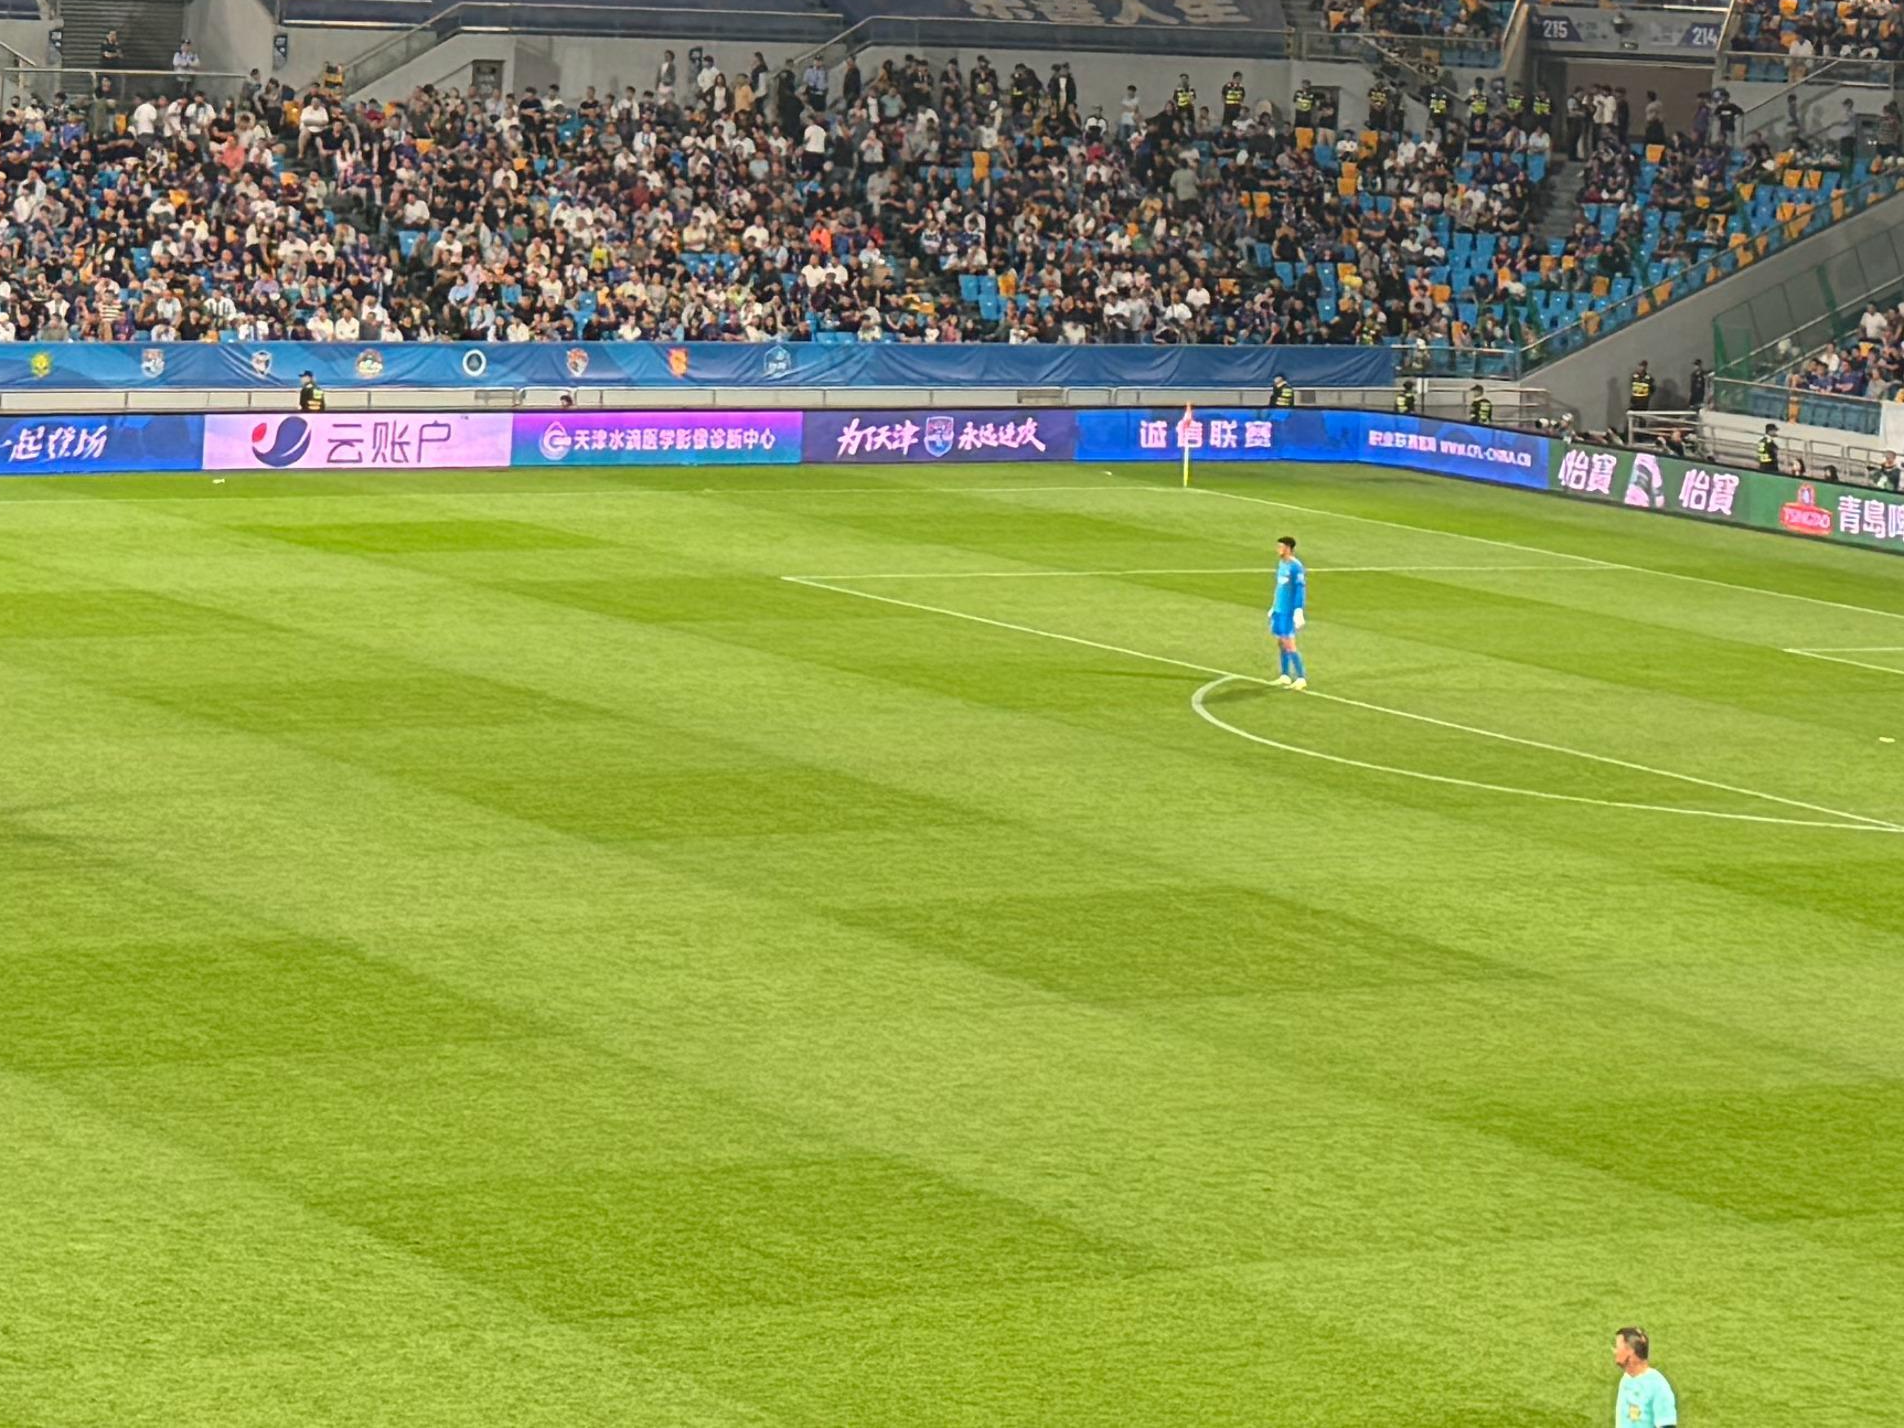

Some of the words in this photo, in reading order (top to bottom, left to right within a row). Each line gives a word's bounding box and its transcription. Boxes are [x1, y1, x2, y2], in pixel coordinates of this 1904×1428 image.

[1542, 19, 1569, 39] 215
[326, 421, 453, 466] 云账户
[1139, 420, 1273, 449] 诚信联赛
[1558, 446, 1619, 498] 怡寶
[1678, 466, 1740, 516] 怡寶
